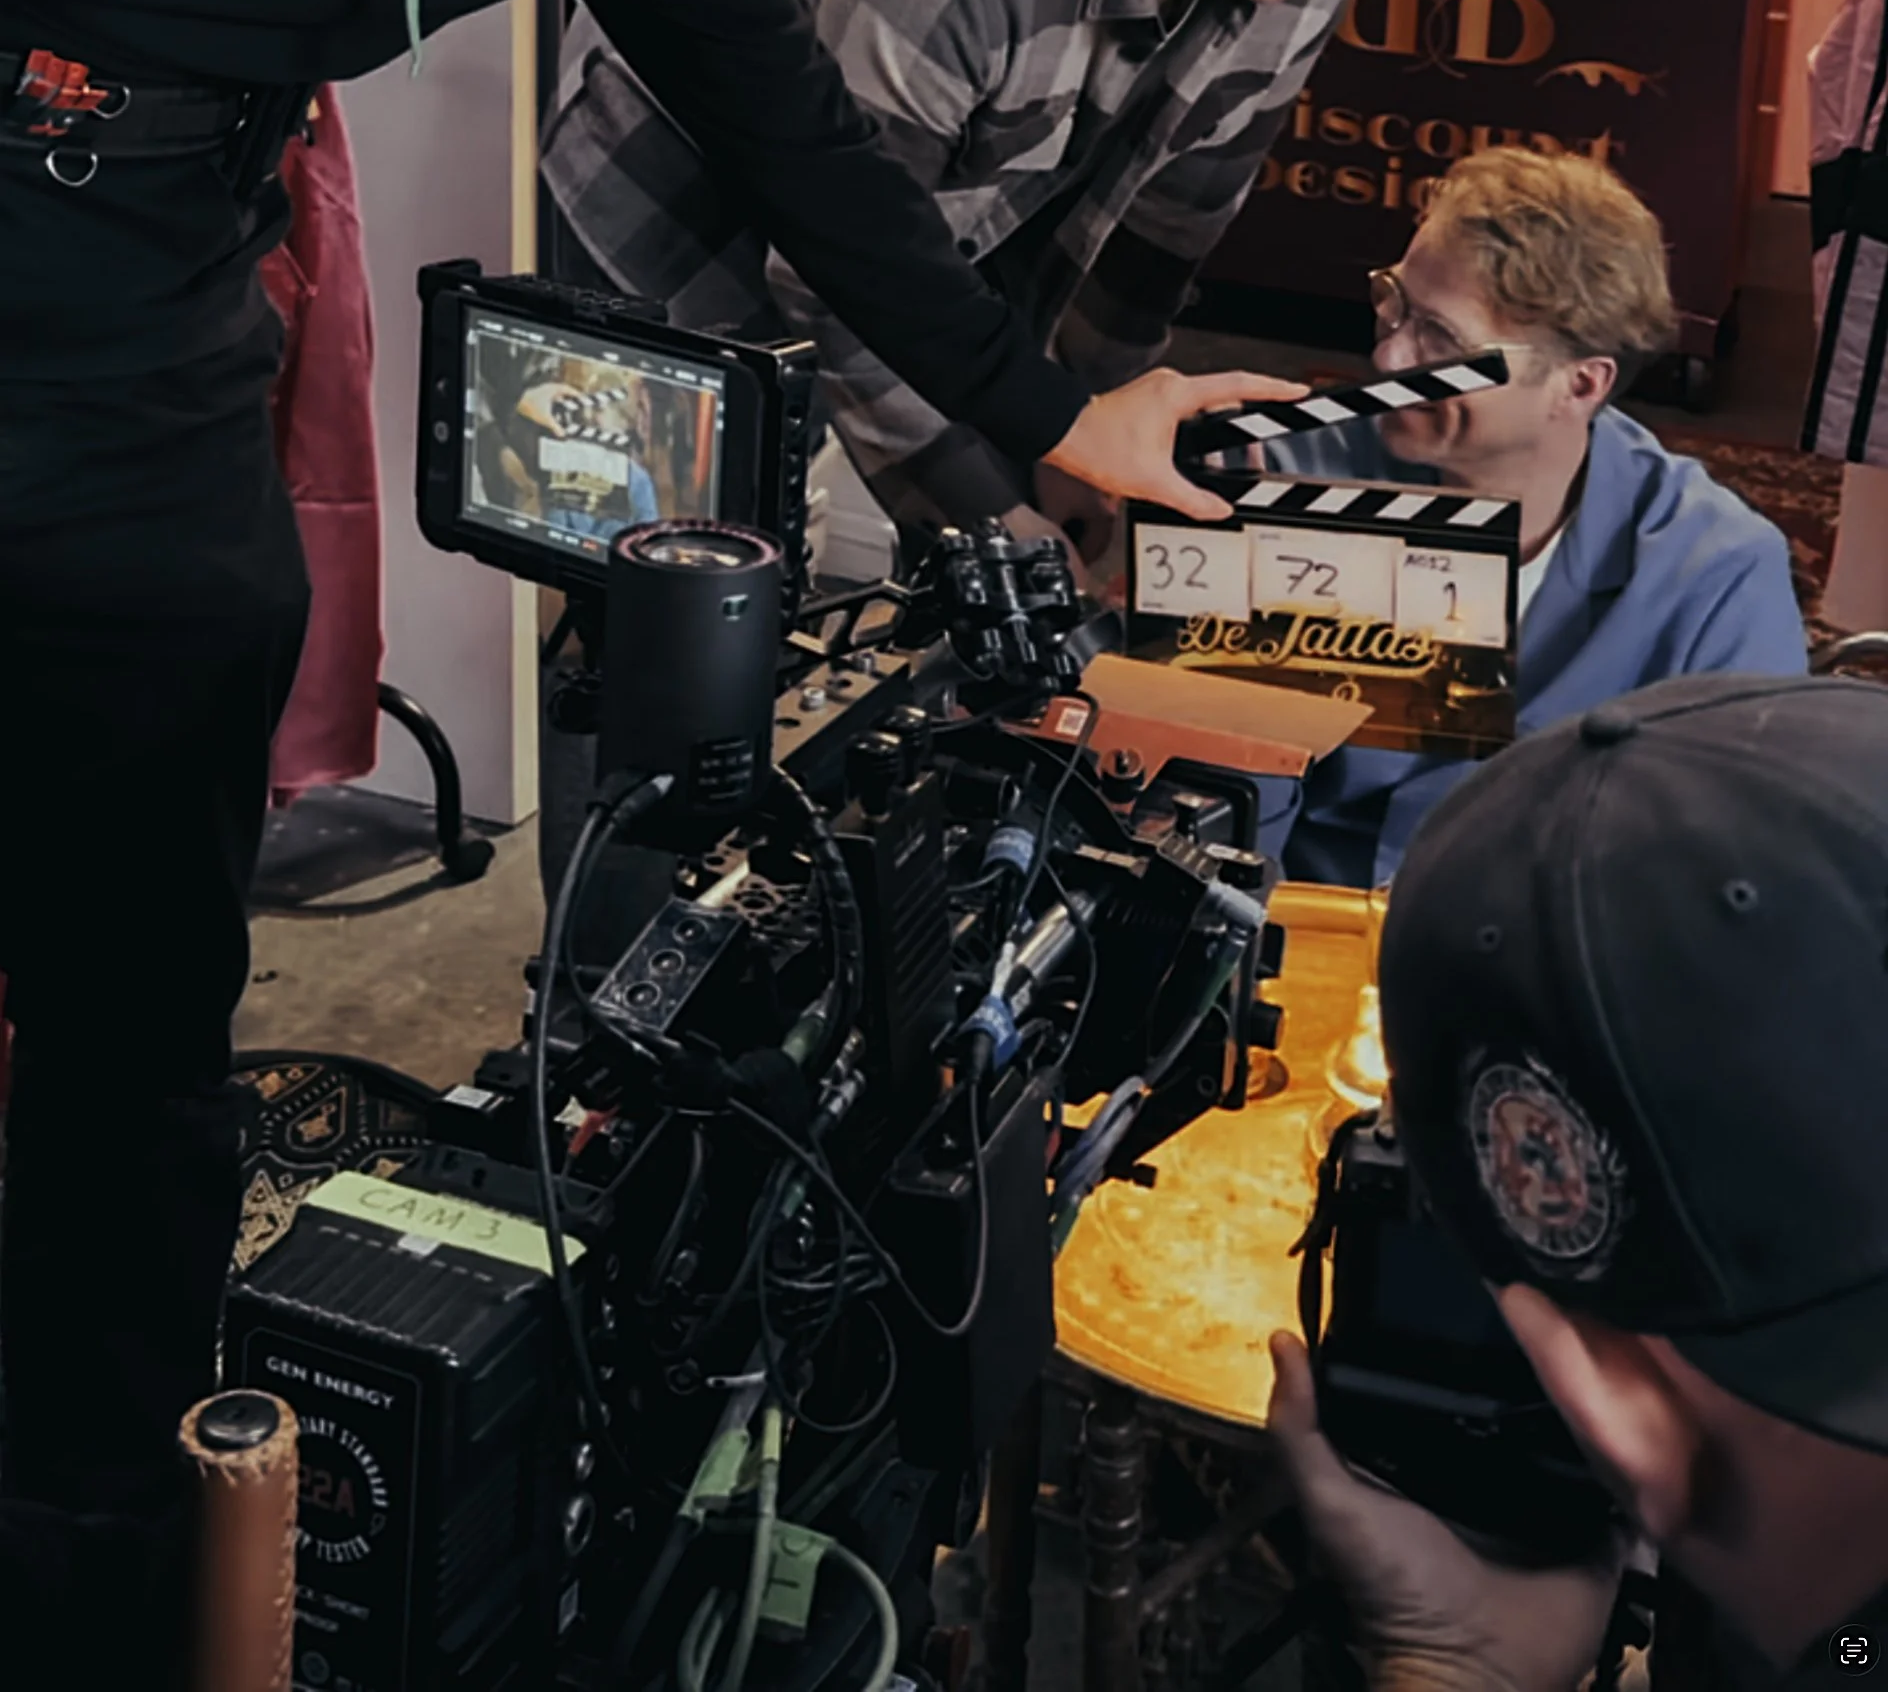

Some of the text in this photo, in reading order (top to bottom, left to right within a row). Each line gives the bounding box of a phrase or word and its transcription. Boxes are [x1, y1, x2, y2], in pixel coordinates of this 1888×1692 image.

[1144, 543, 1210, 591] 32
[1276, 554, 1339, 598] 72
[1442, 580, 1461, 622] 1
[1176, 611, 1250, 653] De
[357, 1188, 502, 1241] CAM 3
[265, 1355, 395, 1410] GEN ENERGY
